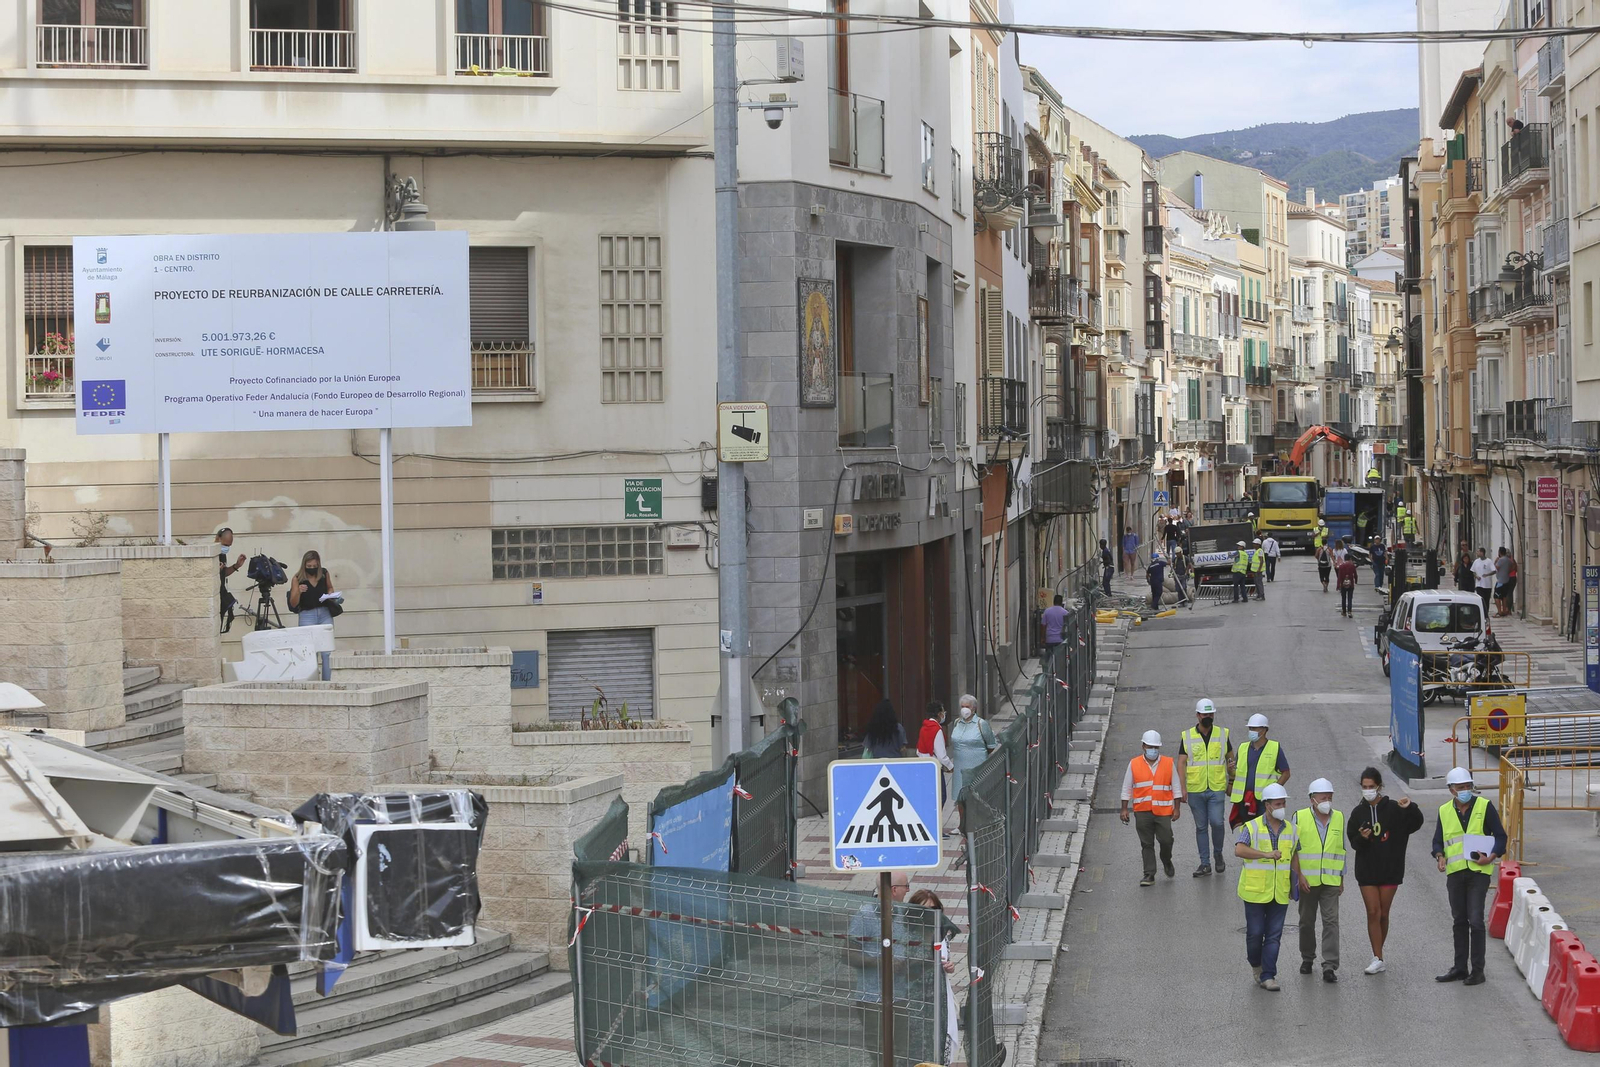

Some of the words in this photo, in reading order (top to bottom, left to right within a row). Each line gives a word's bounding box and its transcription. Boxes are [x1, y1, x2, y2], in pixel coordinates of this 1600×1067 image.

[95, 273, 118, 281] Málaga
[154, 290, 209, 300] PROYECTO
[212, 290, 226, 299] DE
[229, 286, 321, 298] REURBANIZACIÓN
[323, 288, 338, 297] DE
[340, 287, 374, 297] CALLE
[376, 284, 444, 296] CARRETERÍA.
[201, 332, 267, 342] 5.001.973,26
[269, 332, 276, 341] €
[201, 348, 218, 357] UTE
[266, 346, 325, 356] HORMACESA
[229, 377, 263, 386] Proyecto
[265, 376, 317, 384] Cofinanciado
[319, 376, 332, 384] por
[343, 374, 366, 382] Unión
[368, 375, 401, 383] Europea
[164, 395, 204, 404] Programa
[206, 394, 244, 403] Operativo
[246, 393, 268, 401] Feder
[270, 392, 309, 400] Andalucía
[311, 392, 338, 400] (Fondo
[340, 391, 373, 400] Europeo
[387, 390, 427, 398] Desarrollo
[428, 389, 466, 398] Regional)
[321, 408, 343, 416] hacer
[345, 408, 373, 416] Europa
[1585, 568, 1598, 577] BUS
